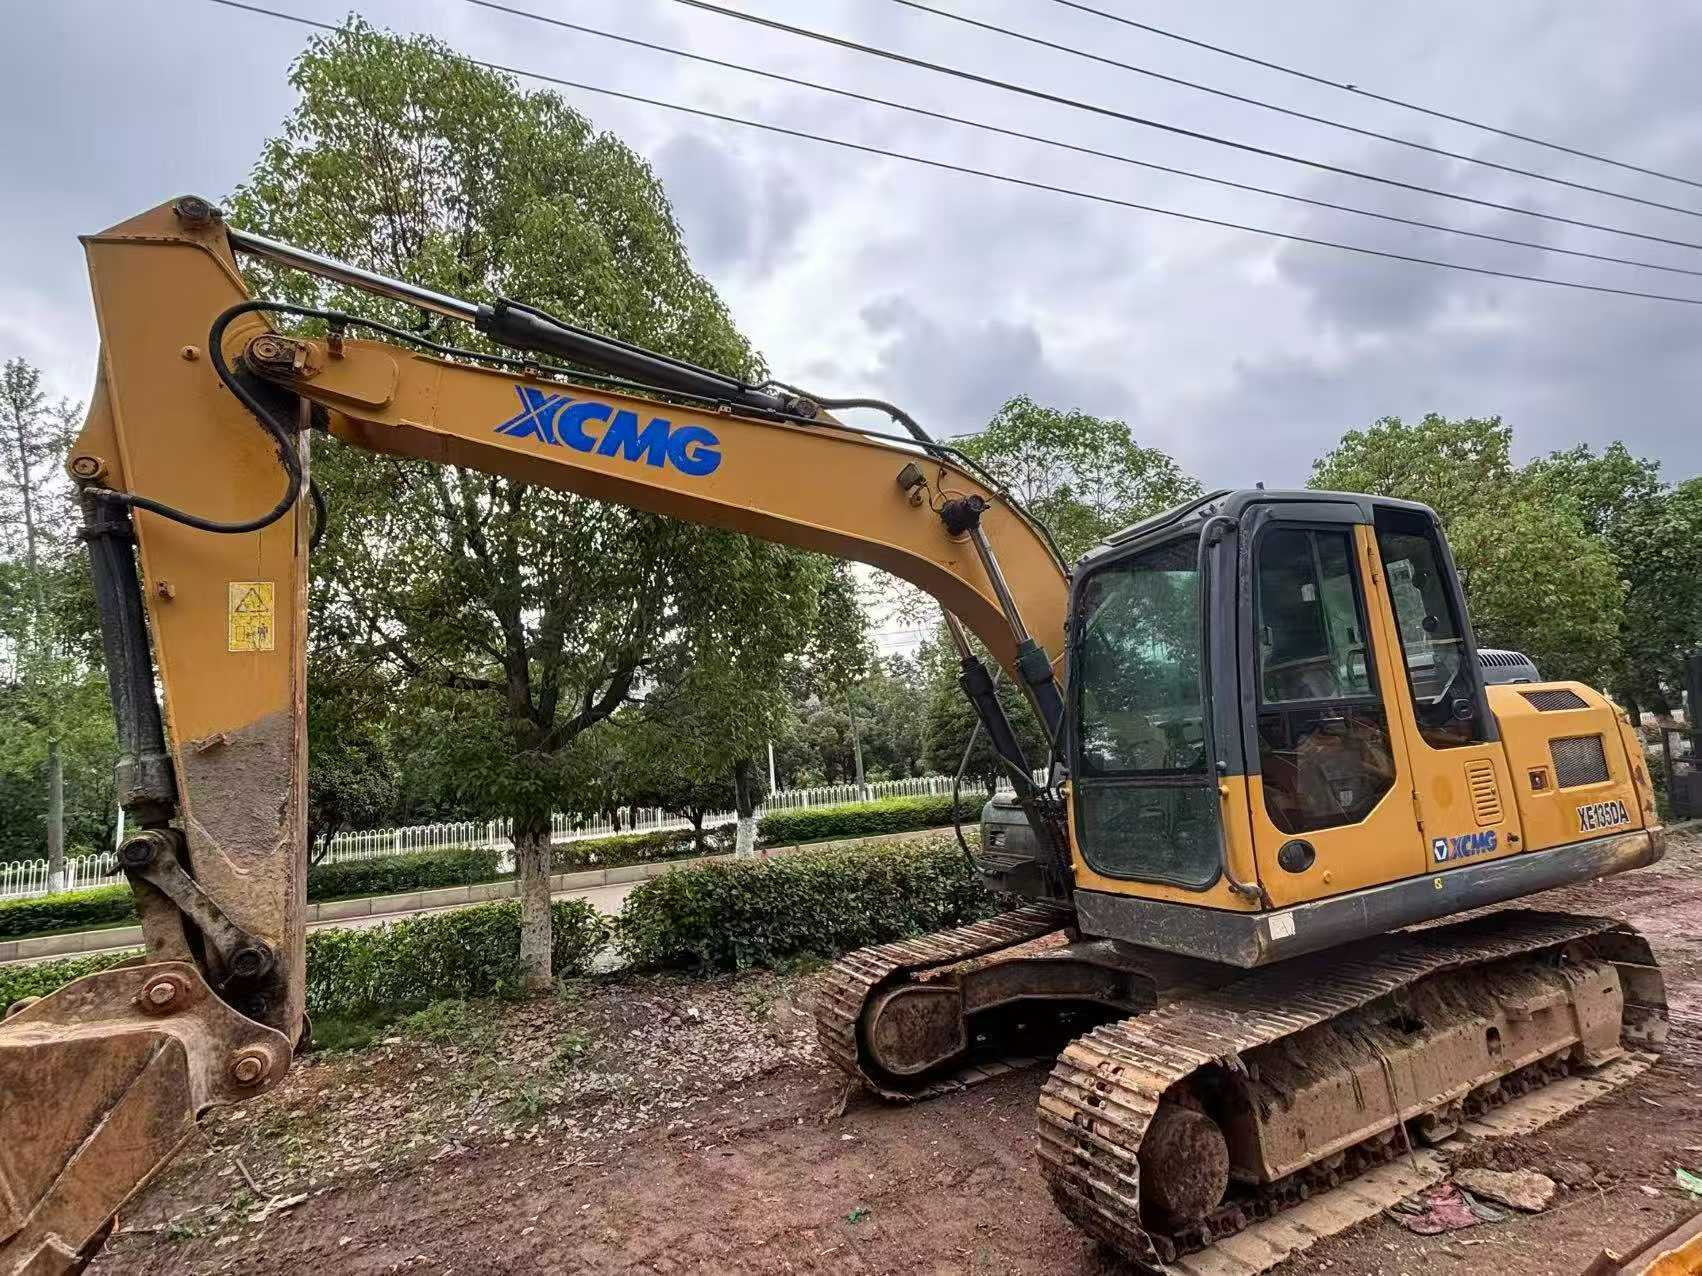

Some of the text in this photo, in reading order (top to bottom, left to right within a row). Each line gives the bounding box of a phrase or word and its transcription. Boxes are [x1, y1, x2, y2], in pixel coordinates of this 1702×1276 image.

[493, 384, 722, 477] XCMG
[1577, 800, 1630, 832] XE135DA
[1448, 830, 1497, 860] XCMG
